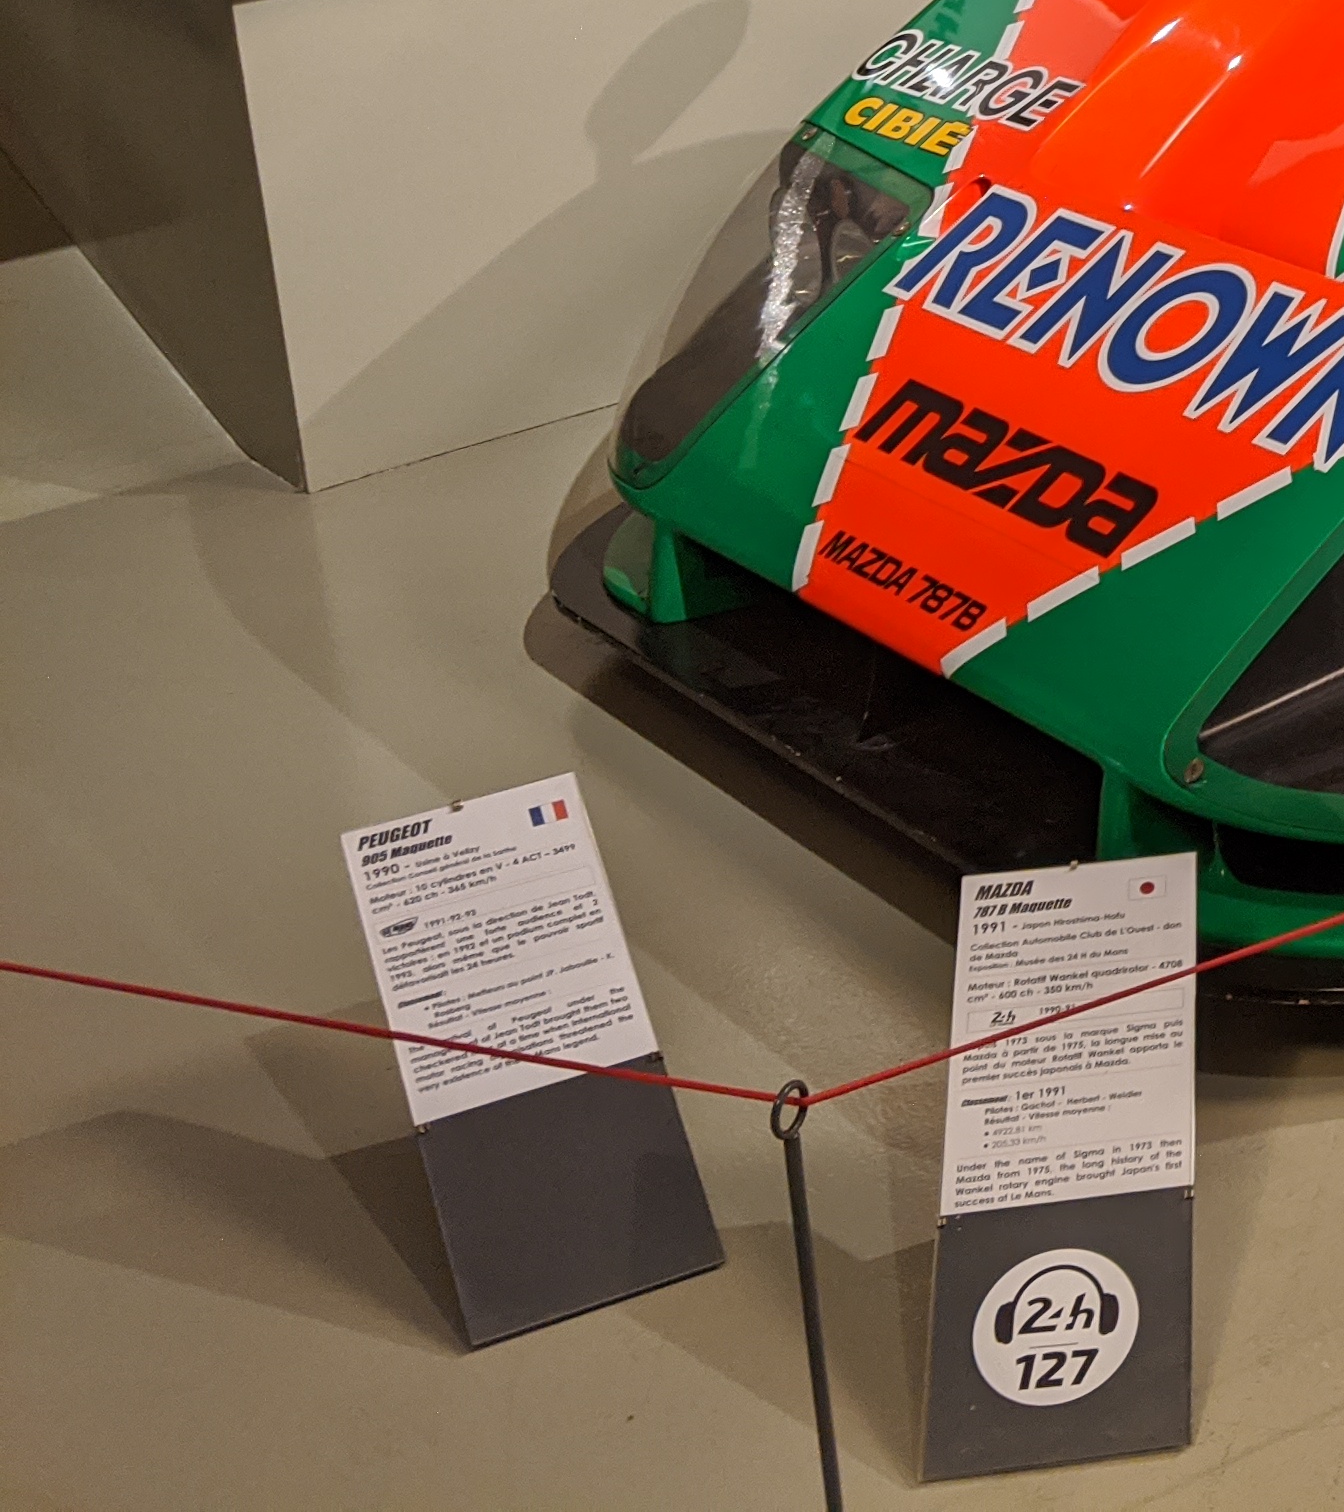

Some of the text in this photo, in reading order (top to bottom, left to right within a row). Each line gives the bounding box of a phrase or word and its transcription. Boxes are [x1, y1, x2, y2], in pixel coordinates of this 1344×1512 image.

[853, 29, 1086, 131] CHARGE
[819, 531, 988, 632] MAZDA 787B
[357, 819, 433, 851] PEUGEOT
[361, 835, 453, 867] 905 Maquette
[363, 863, 400, 881] 1990
[974, 880, 1034, 901] MAZDA
[1007, 897, 1073, 915] Maquette
[969, 939, 1020, 951] Collection
[1021, 933, 1077, 946] Automobile
[1079, 929, 1102, 939] Club
[1104, 928, 1117, 936] de
[971, 921, 1006, 935] 1991
[966, 980, 1005, 991] Moteur
[1014, 1089, 1034, 1101] 1er
[1038, 1085, 1066, 1097] 1991
[954, 1173, 991, 1184] Mazda
[996, 1169, 1020, 1179] from
[1058, 1162, 1076, 1171] the
[1081, 1159, 1104, 1170] long
[1110, 1154, 1143, 1167] history
[1149, 1152, 1160, 1160] of
[1165, 1149, 1182, 1158] the
[955, 1162, 986, 1173] Under
[994, 1159, 1010, 1168] the
[1017, 1155, 1048, 1165] name
[1055, 1152, 1067, 1161] of
[1073, 1147, 1105, 1160] Sigma
[1112, 1145, 1121, 1153] in
[1159, 1138, 1182, 1147] then
[954, 1184, 993, 1196] Wankel
[997, 1180, 1028, 1192] rotary
[1034, 1175, 1070, 1187] engine
[1076, 1168, 1116, 1182] brought
[1164, 1160, 1182, 1170] first
[953, 1195, 995, 1208] success
[996, 1194, 1008, 1203] at
[1009, 1192, 1021, 1201] Le
[1015, 1348, 1100, 1391] 127
